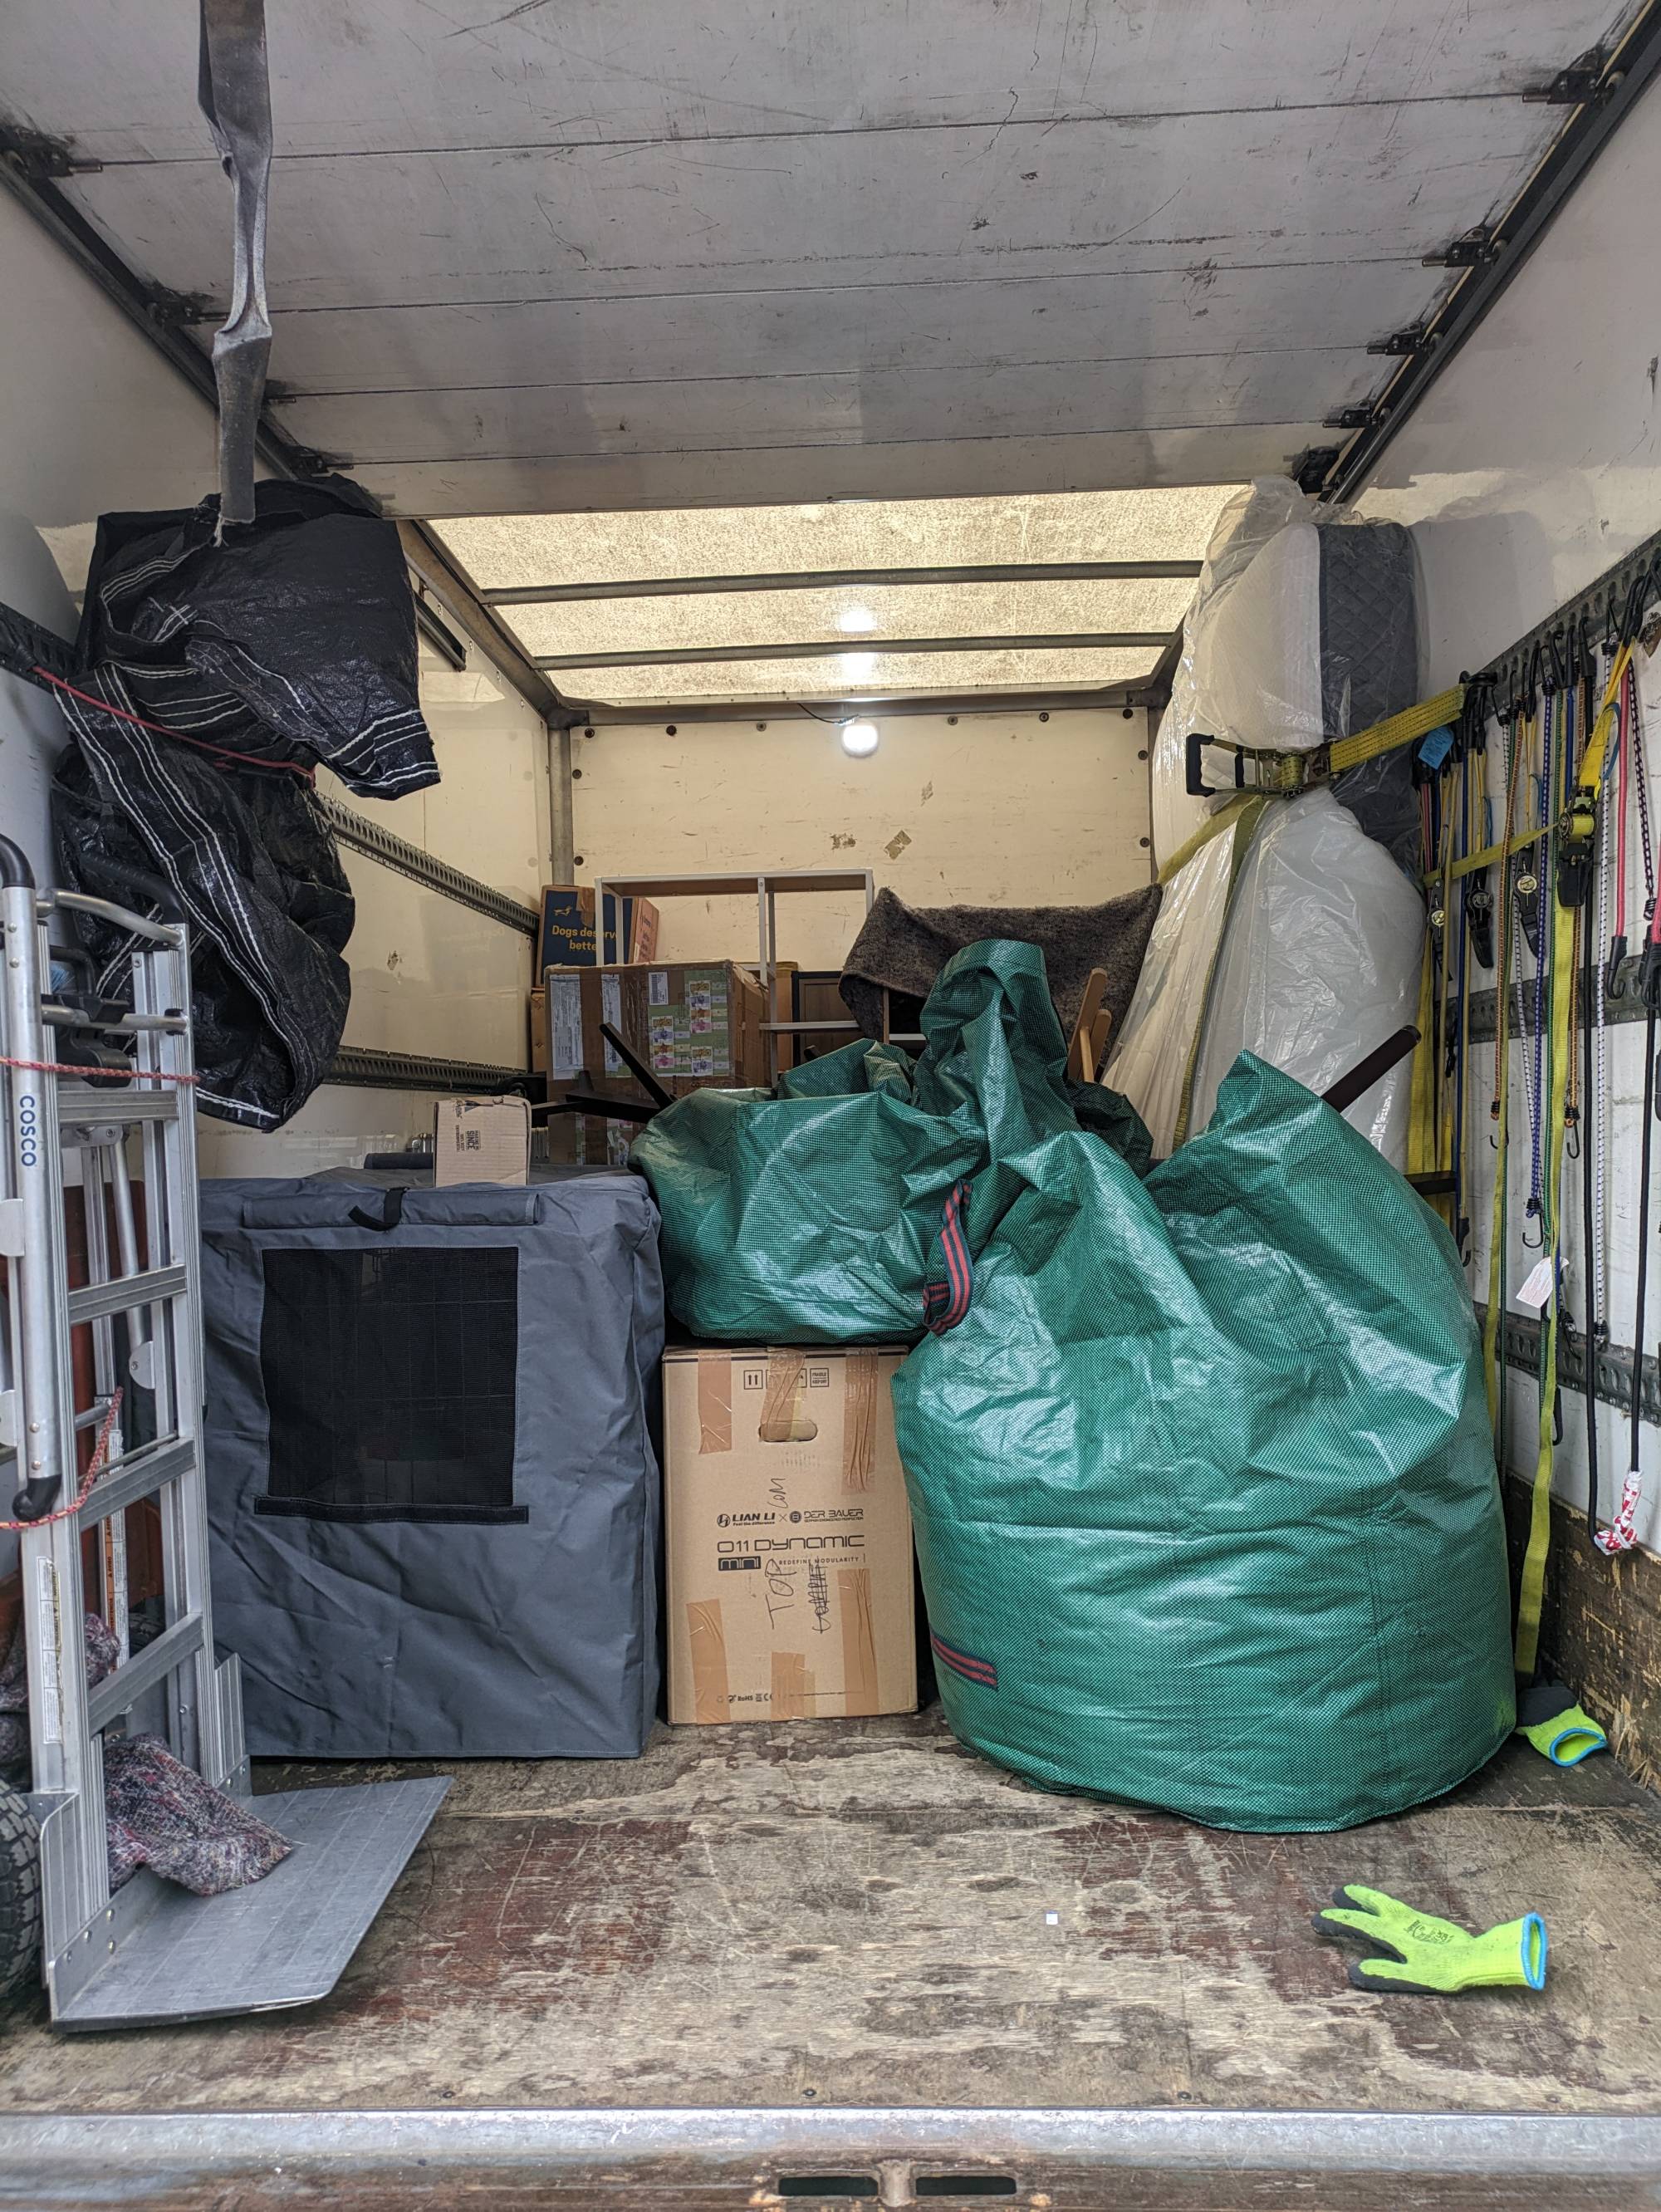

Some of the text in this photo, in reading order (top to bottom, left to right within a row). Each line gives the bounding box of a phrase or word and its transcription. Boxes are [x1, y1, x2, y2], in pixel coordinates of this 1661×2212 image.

[551, 925, 578, 939] Dogs
[569, 939, 597, 951] bette
[20, 1095, 37, 1167] COSCO
[732, 1513, 761, 1522] LIAN
[763, 1512, 776, 1520] LI
[764, 1558, 797, 1631] TOP
